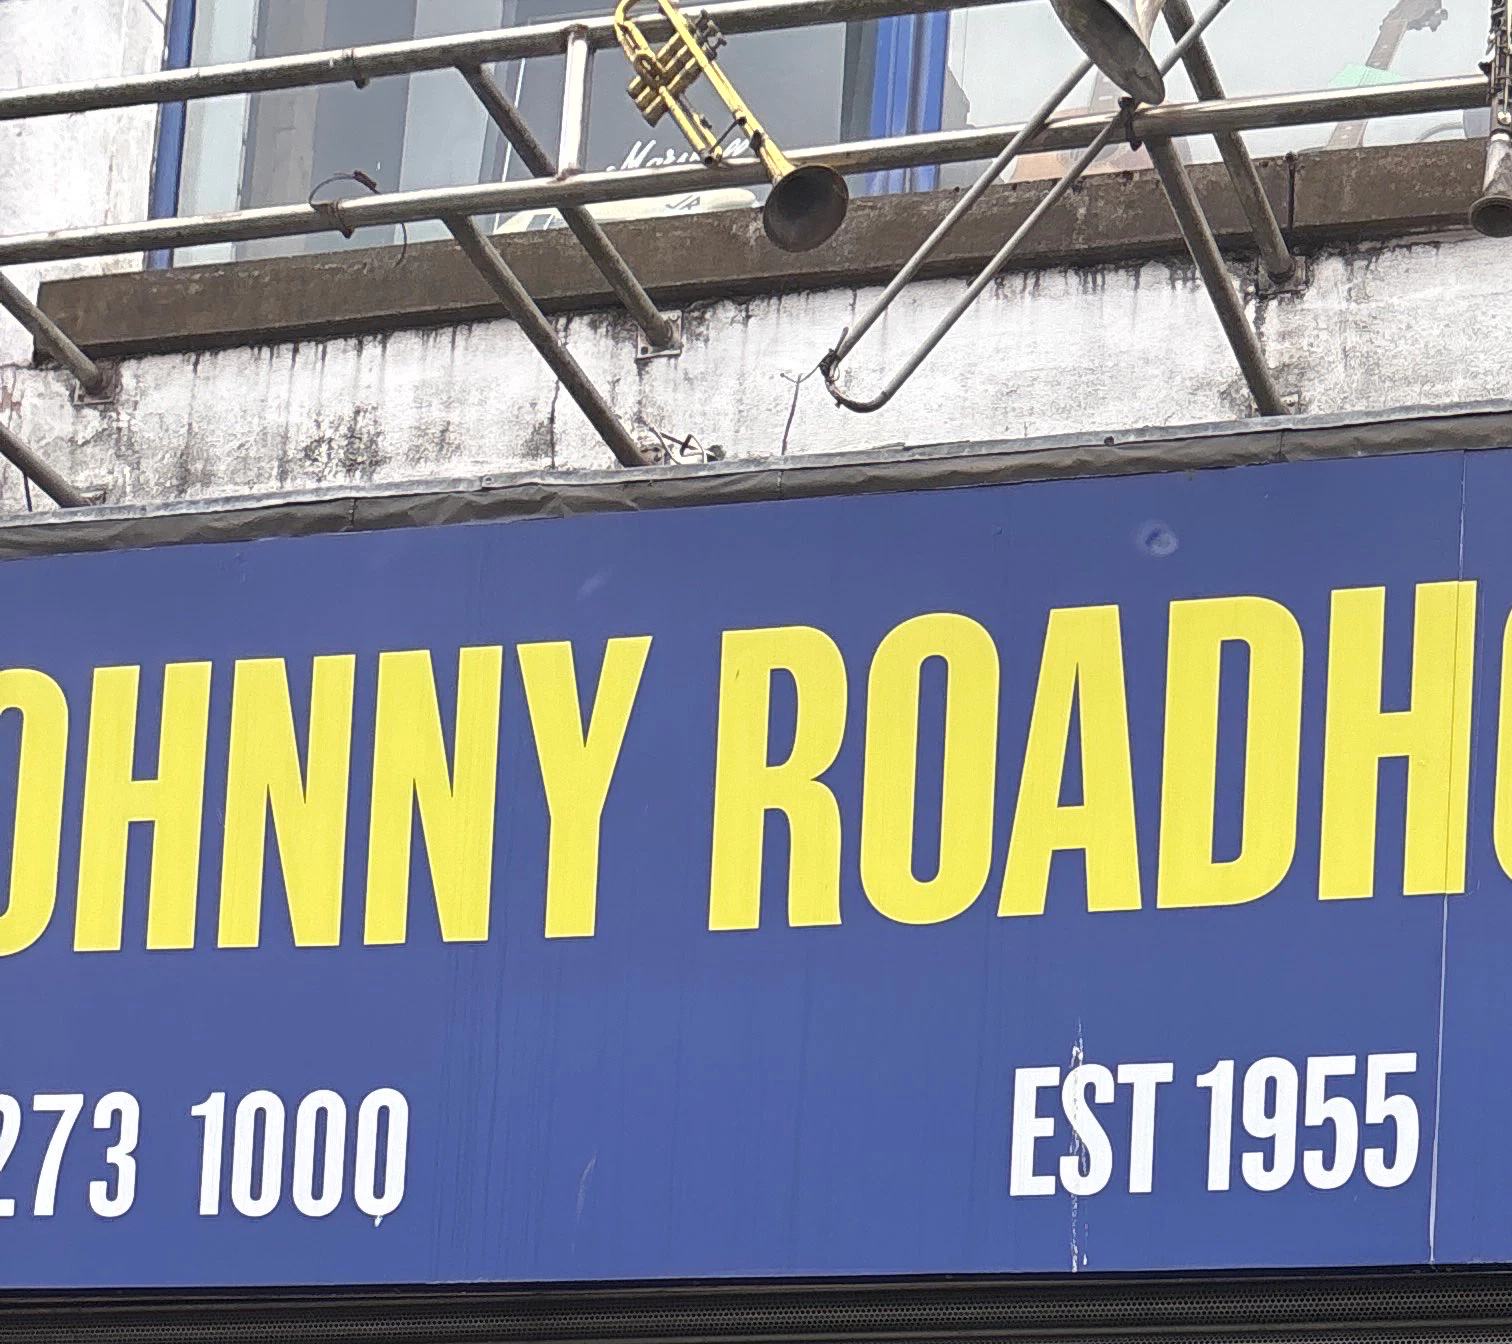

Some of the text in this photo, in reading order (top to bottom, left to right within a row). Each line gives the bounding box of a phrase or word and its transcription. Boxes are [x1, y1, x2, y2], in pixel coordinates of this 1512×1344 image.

[191, 1087, 409, 1218] 1000
[1009, 1053, 1420, 1197] EST 1955
